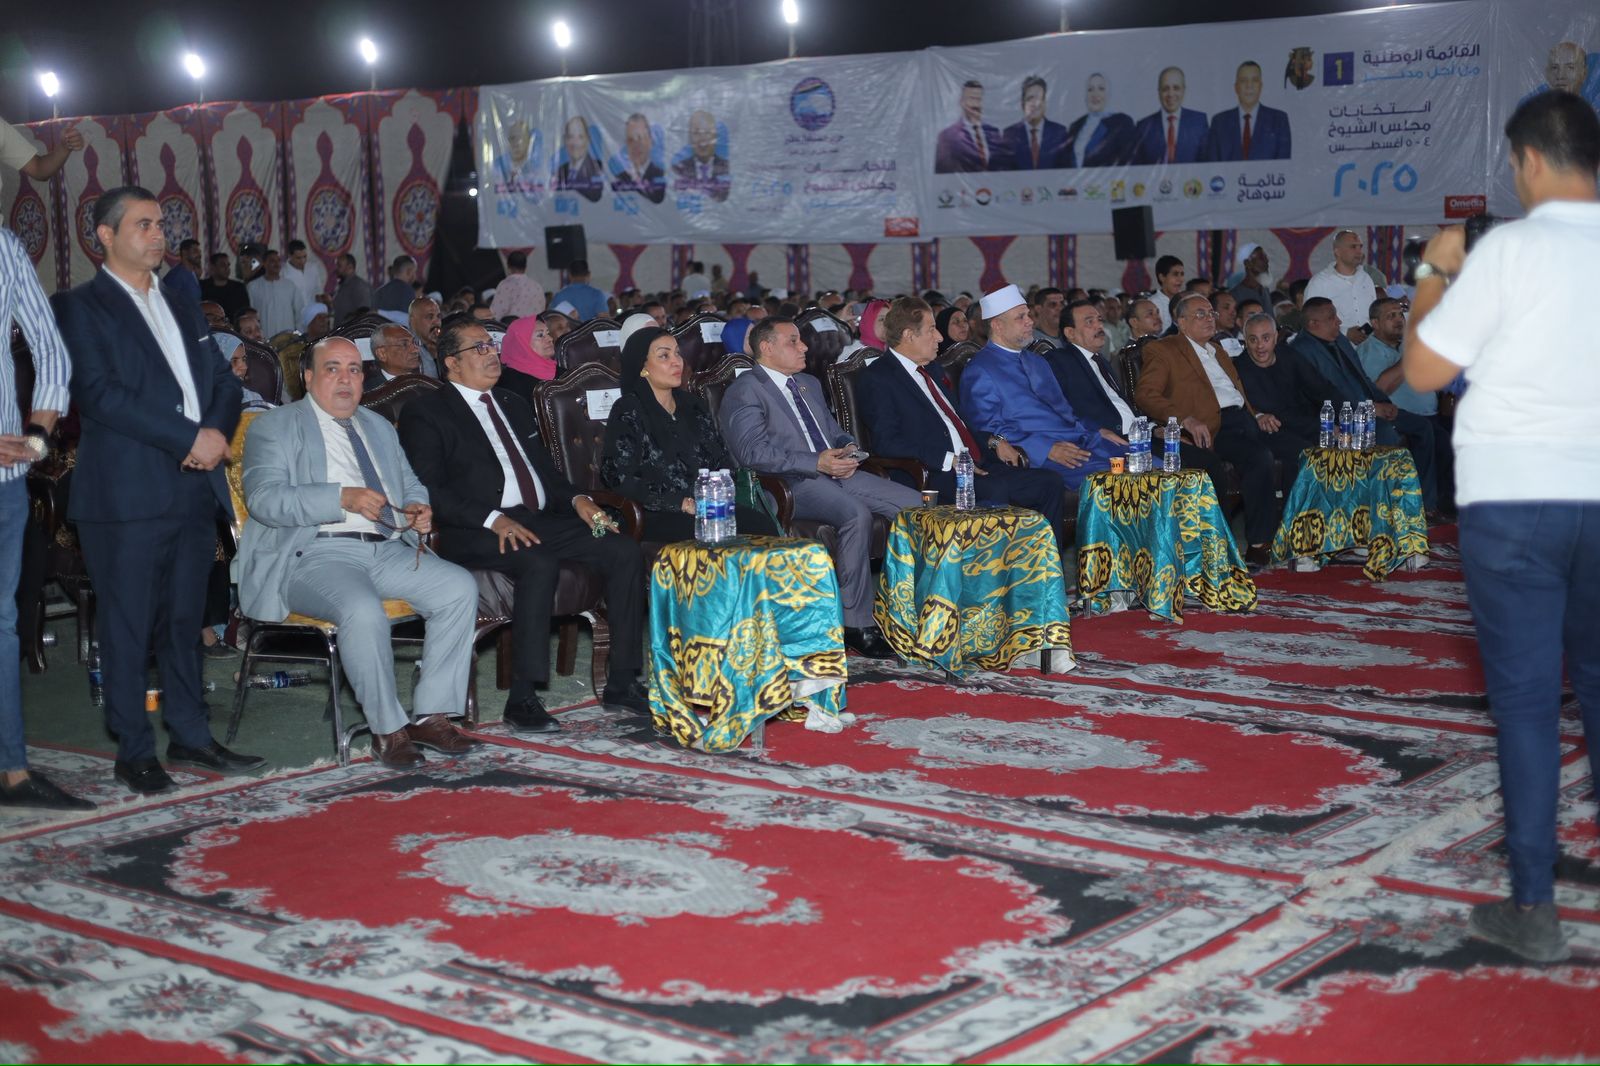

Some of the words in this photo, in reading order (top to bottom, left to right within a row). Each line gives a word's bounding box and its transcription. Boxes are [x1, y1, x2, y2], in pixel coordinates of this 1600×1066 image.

[1363, 48, 1423, 67] الوطنية
[1426, 44, 1480, 61] القائمة
[1329, 100, 1432, 119] انتخابات
[1328, 118, 1377, 138] الشيوخ
[1380, 119, 1432, 136] مجلس
[1328, 136, 1403, 154] أغسطس
[1237, 172, 1286, 188] قائمة
[1333, 161, 1418, 198] ٢٠٢٥
[1237, 187, 1286, 203] سوهاج
